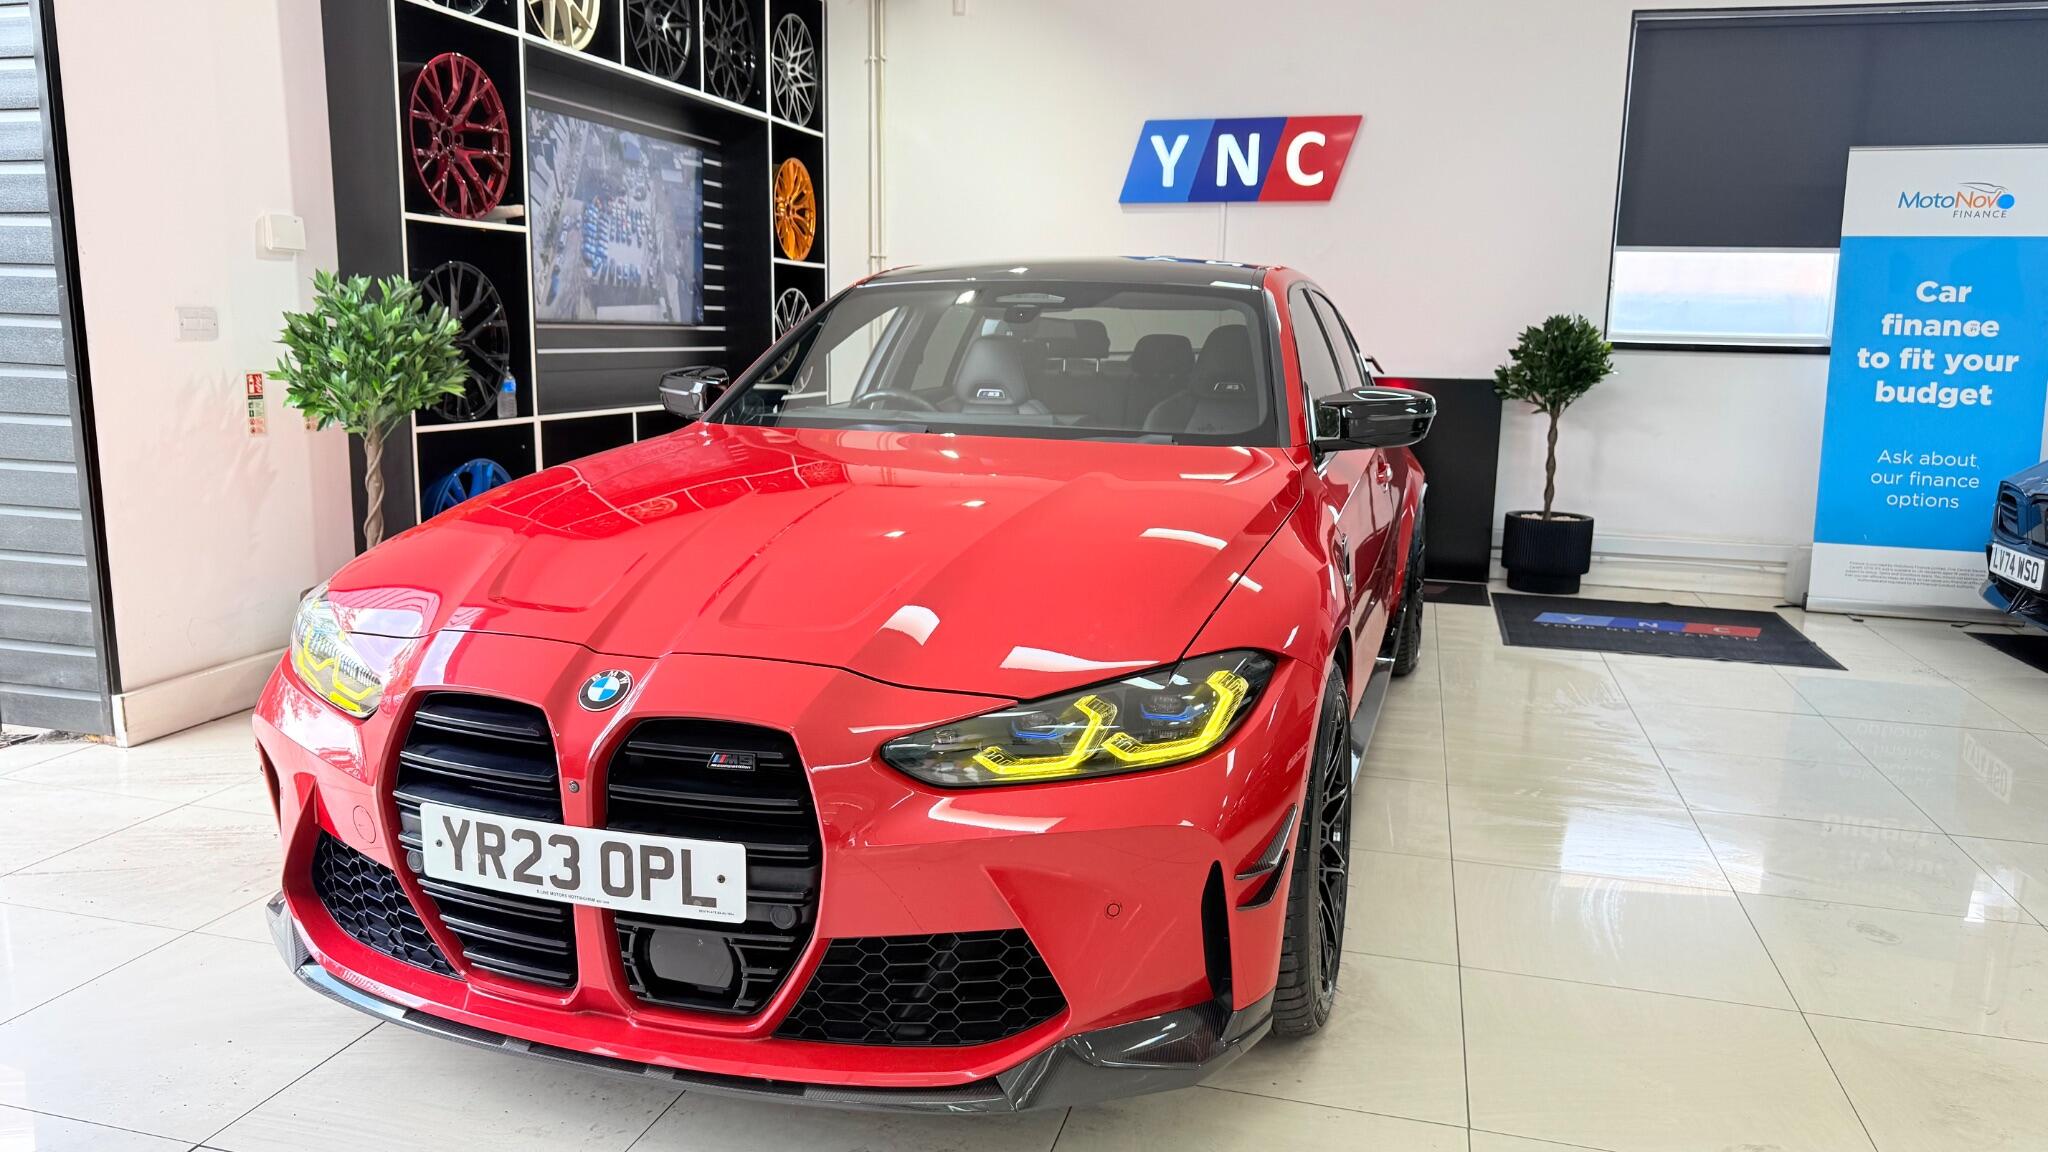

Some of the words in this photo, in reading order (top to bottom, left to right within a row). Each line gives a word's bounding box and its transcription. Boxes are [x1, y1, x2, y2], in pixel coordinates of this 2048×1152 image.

[1150, 131, 1326, 188] YNC
[1953, 210, 2008, 219] FINANCE
[1916, 281, 1972, 303] Car
[1881, 313, 2000, 337] finance
[1857, 348, 1890, 369] to
[1899, 348, 1935, 370] fit
[1943, 353, 2020, 375] your
[1875, 380, 1993, 408] budget
[1877, 449, 1914, 465] Ask
[1919, 451, 1977, 467] about
[1870, 472, 1902, 485] our
[1909, 471, 1980, 489] finance
[1886, 492, 1960, 509] options
[442, 815, 581, 891] YR23
[600, 840, 717, 908] OPL
